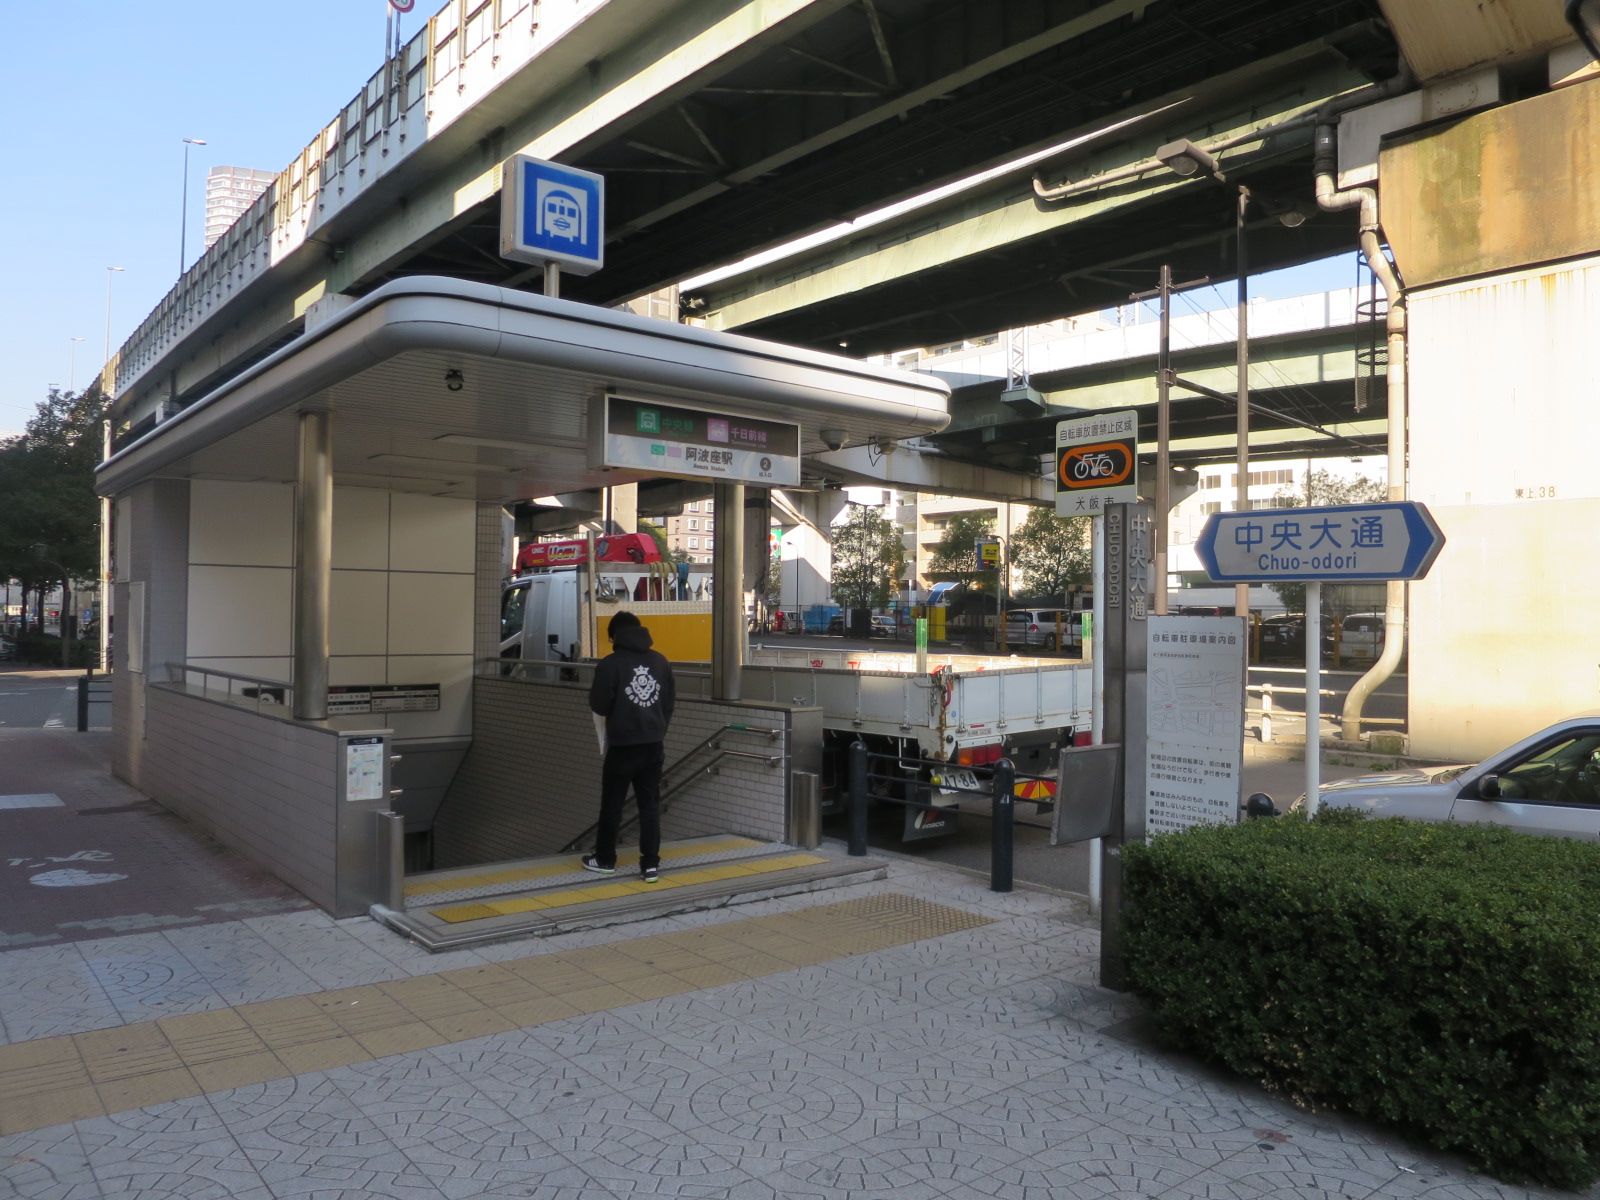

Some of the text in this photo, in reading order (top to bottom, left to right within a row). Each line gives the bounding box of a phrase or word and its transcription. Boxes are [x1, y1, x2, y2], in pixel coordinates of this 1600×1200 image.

[1060, 419, 1132, 440] 自転車放置禁止区域
[685, 446, 734, 466] 阿波座駅
[1075, 496, 1115, 511] 大阪市
[1235, 516, 1384, 553] 中央大通
[1130, 513, 1146, 621] 中央大通
[1258, 552, 1358, 571] Chuo-odori
[1152, 633, 1236, 645] 自転車駐車場案内図
